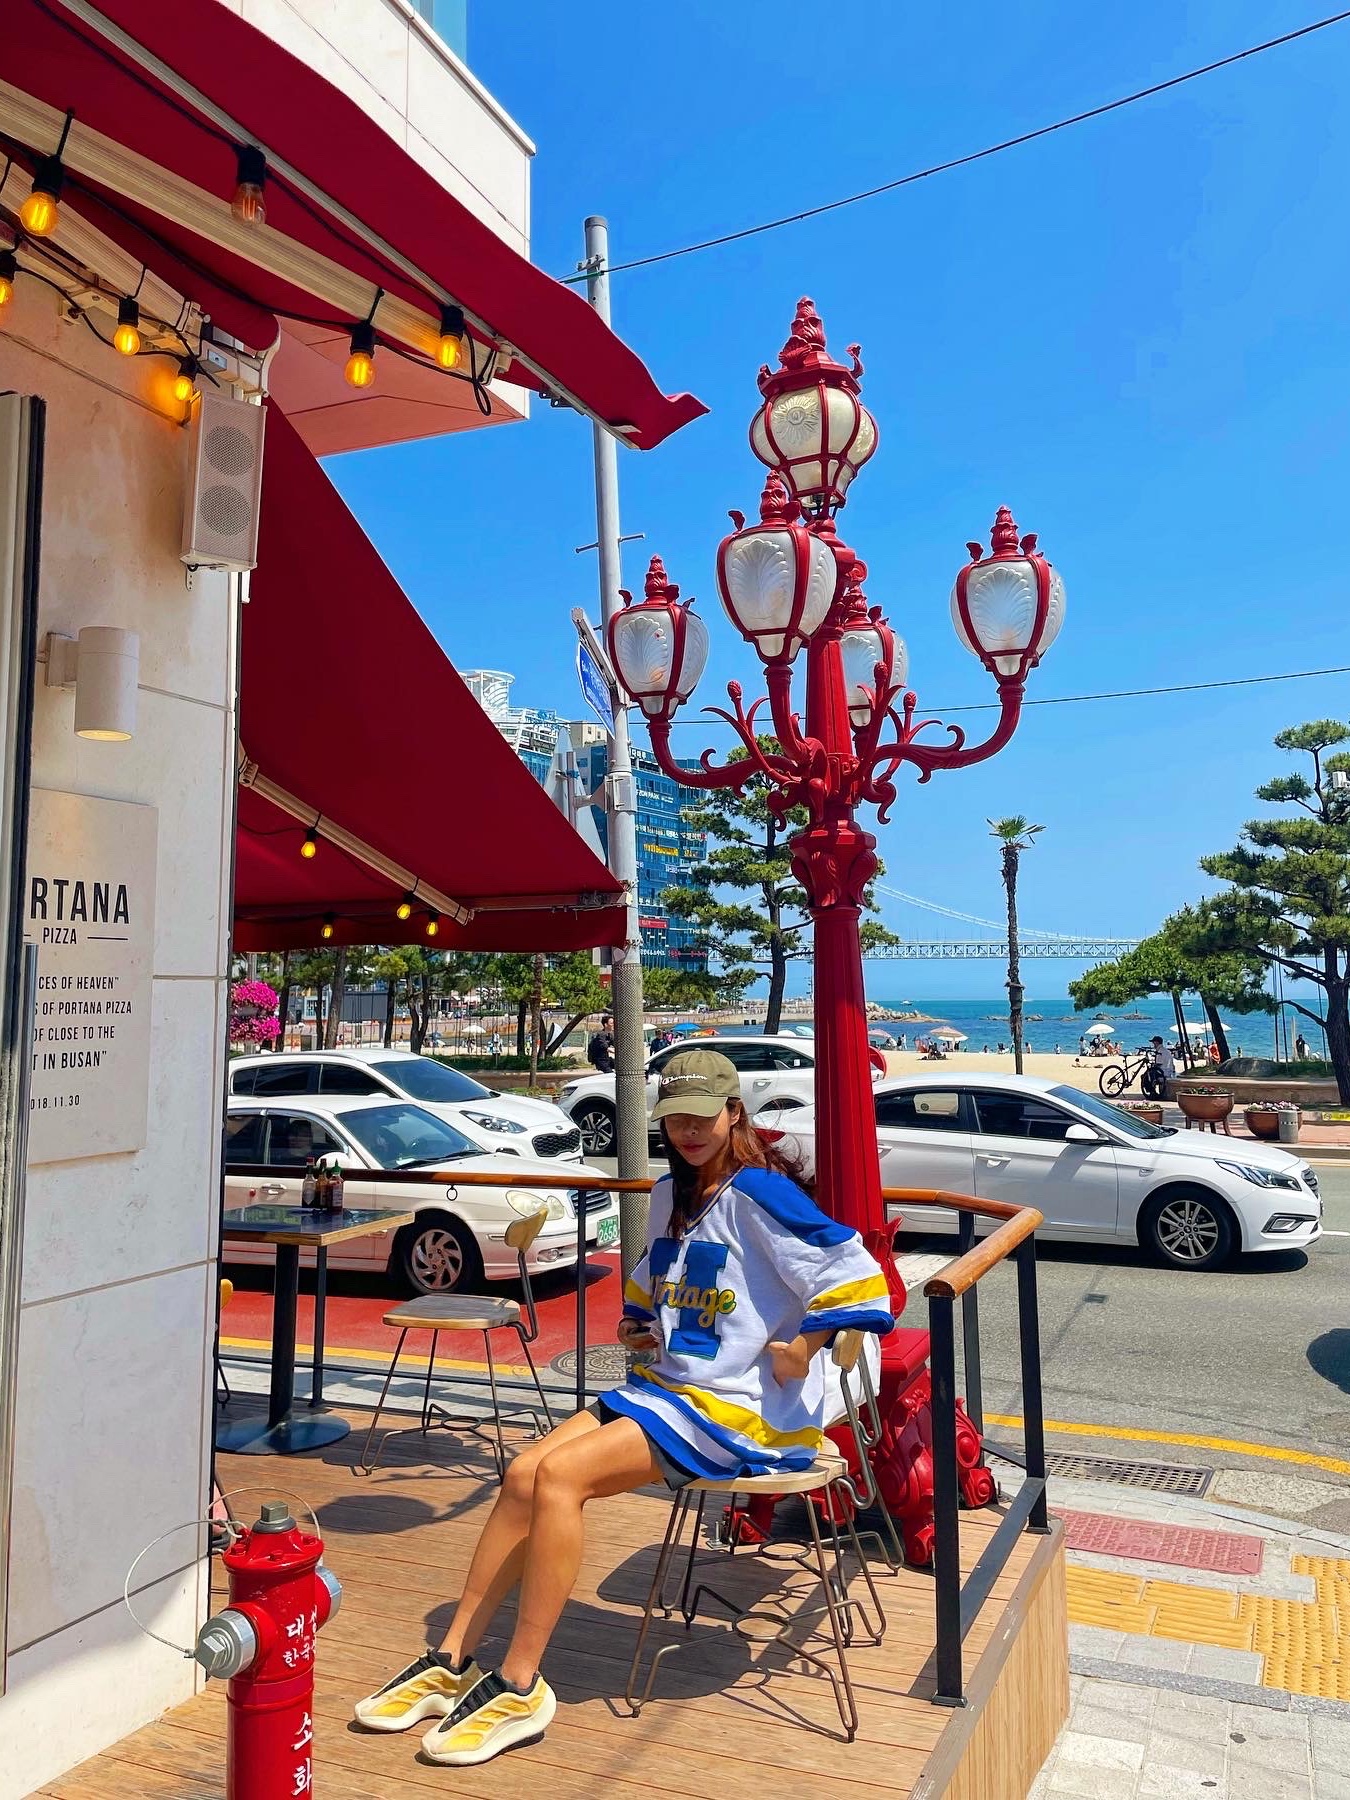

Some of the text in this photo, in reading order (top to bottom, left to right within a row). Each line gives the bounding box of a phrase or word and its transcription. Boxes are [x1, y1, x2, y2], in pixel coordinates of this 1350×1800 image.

[30, 877, 130, 924] RTANA
[43, 927, 77, 945] PIZZA
[38, 976, 57, 990] CES
[61, 976, 73, 989] OF
[42, 1002, 55, 1015] OF
[58, 1001, 102, 1015] PORTANA
[106, 1000, 132, 1014] PIZZA
[48, 1026, 78, 1041] CLOSE
[83, 1026, 94, 1040] TO
[98, 1025, 115, 1039] THE
[43, 1053, 56, 1070] IN
[598, 1224, 618, 1243] 2658
